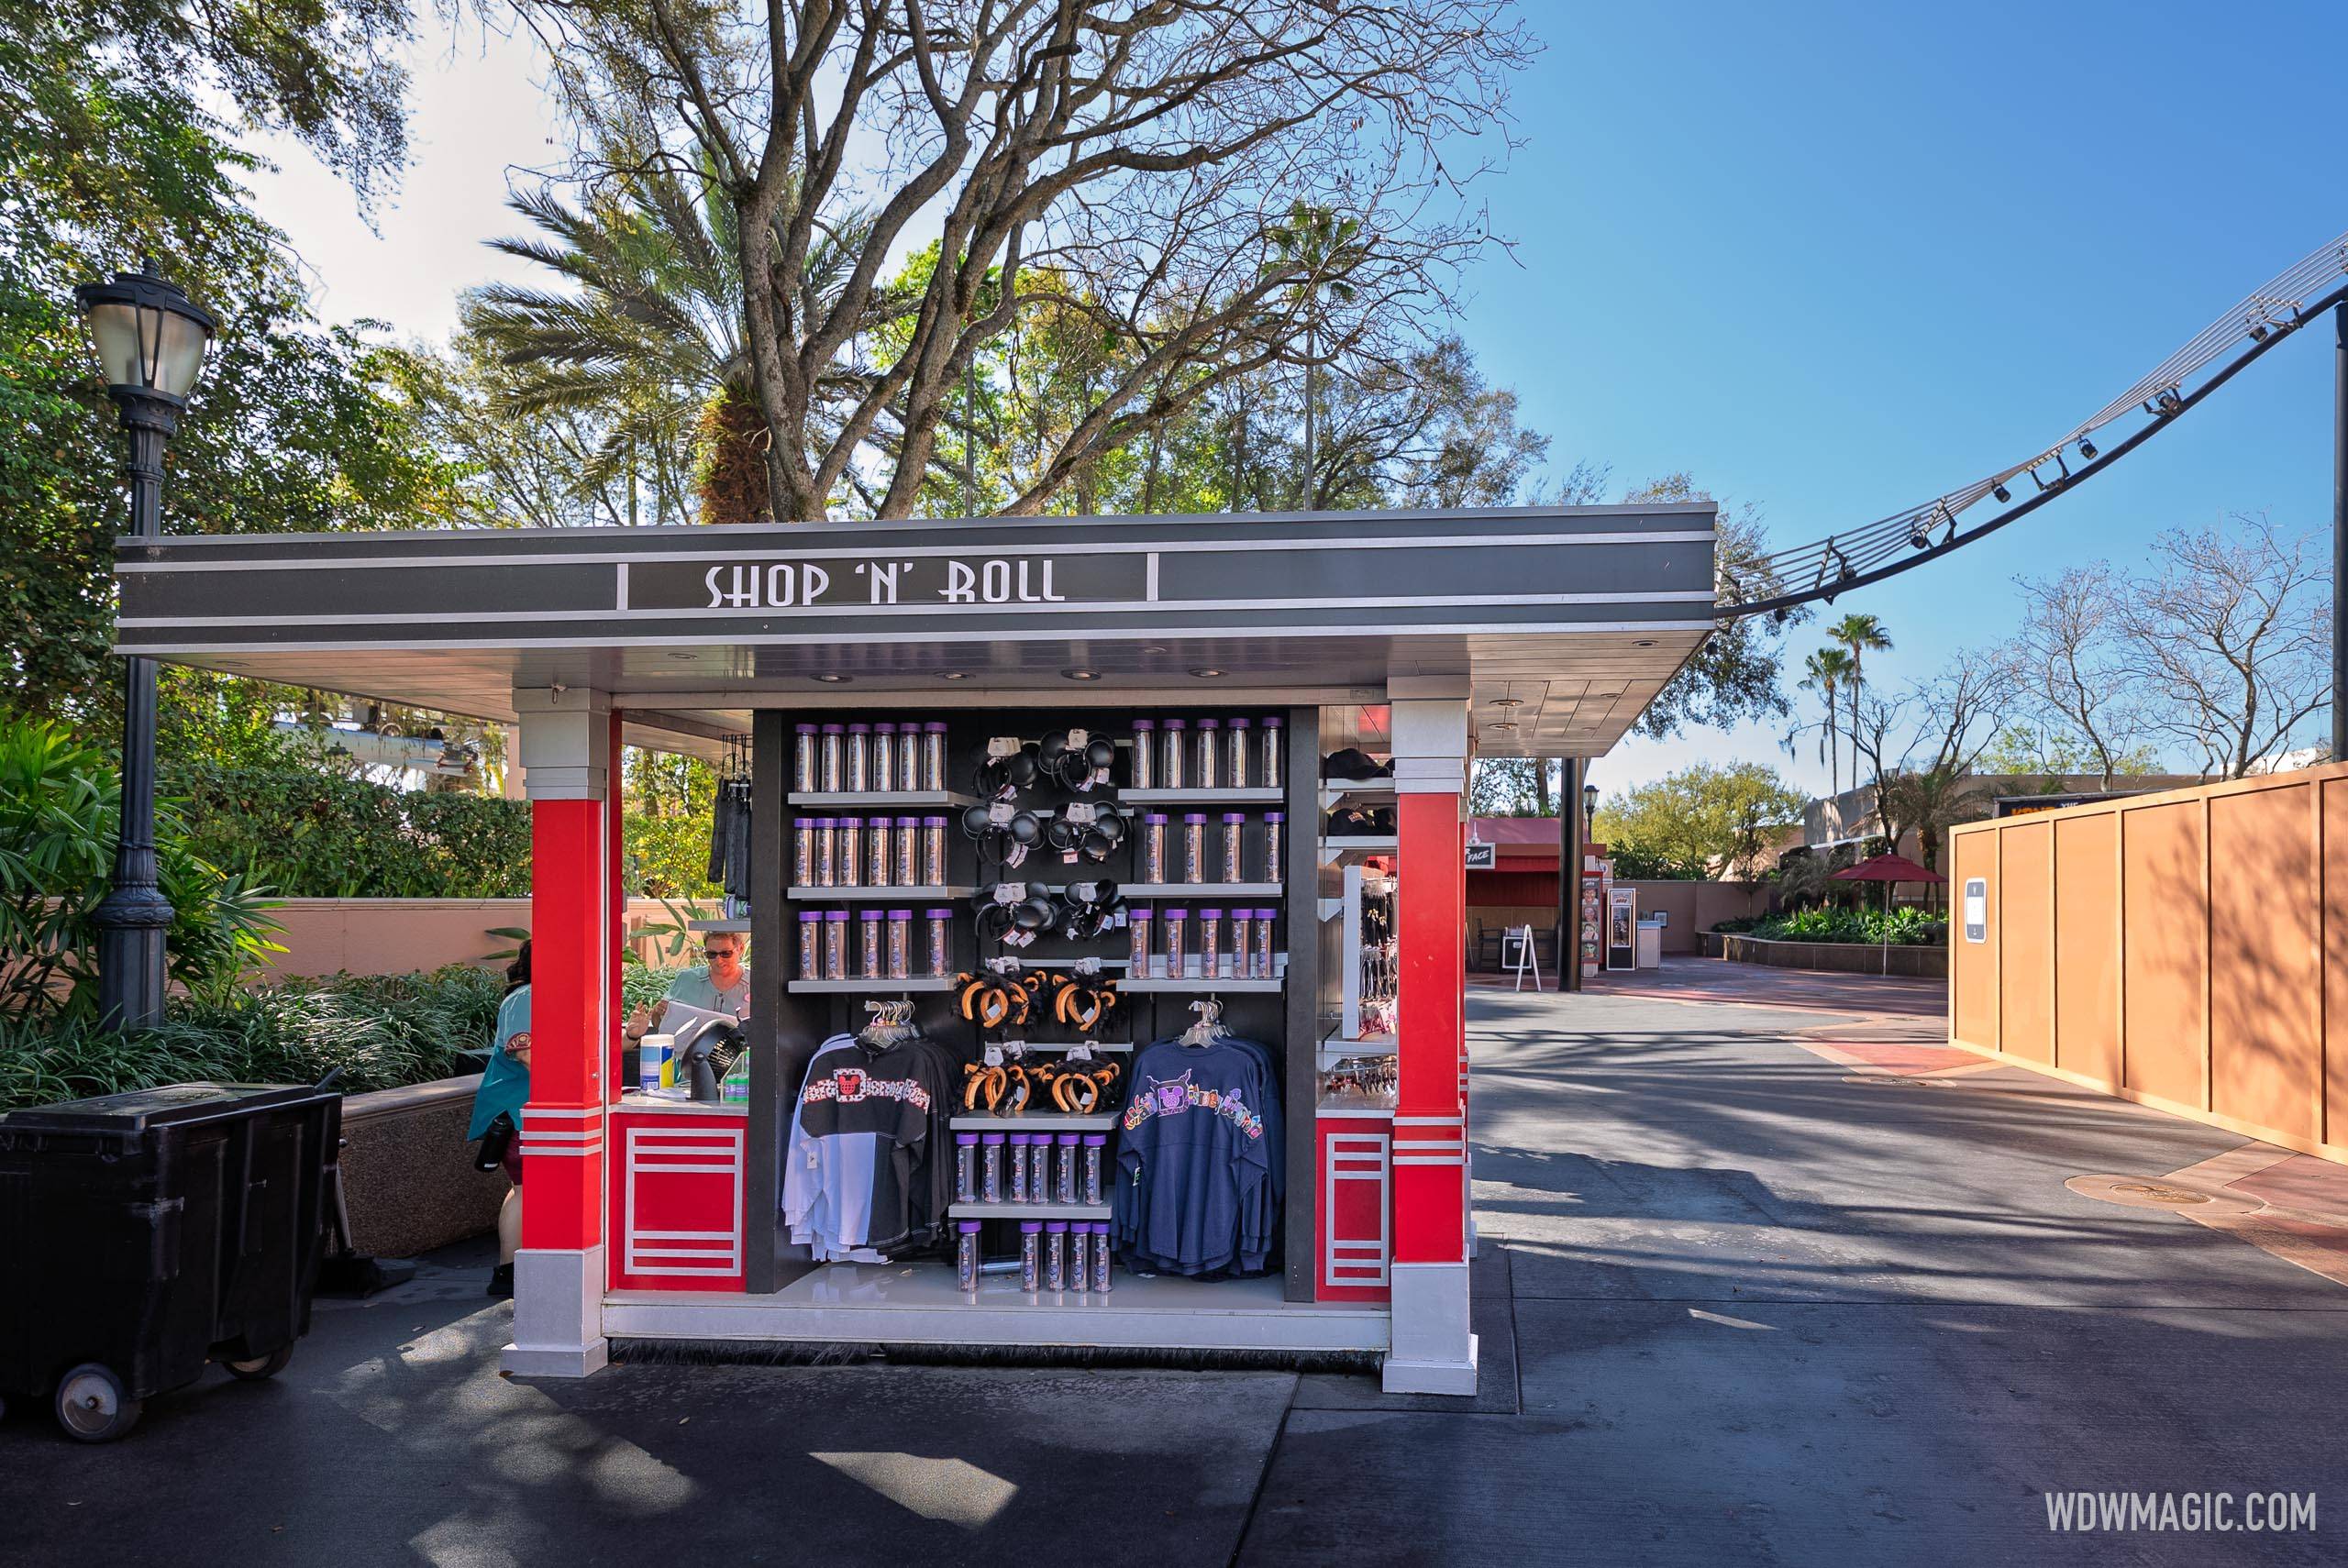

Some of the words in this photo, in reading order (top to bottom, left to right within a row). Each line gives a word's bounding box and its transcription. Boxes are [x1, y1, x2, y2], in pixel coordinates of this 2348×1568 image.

[705, 563, 829, 608] SHOP
[937, 558, 1066, 603] ROLL
[1468, 850, 1490, 864] FACE
